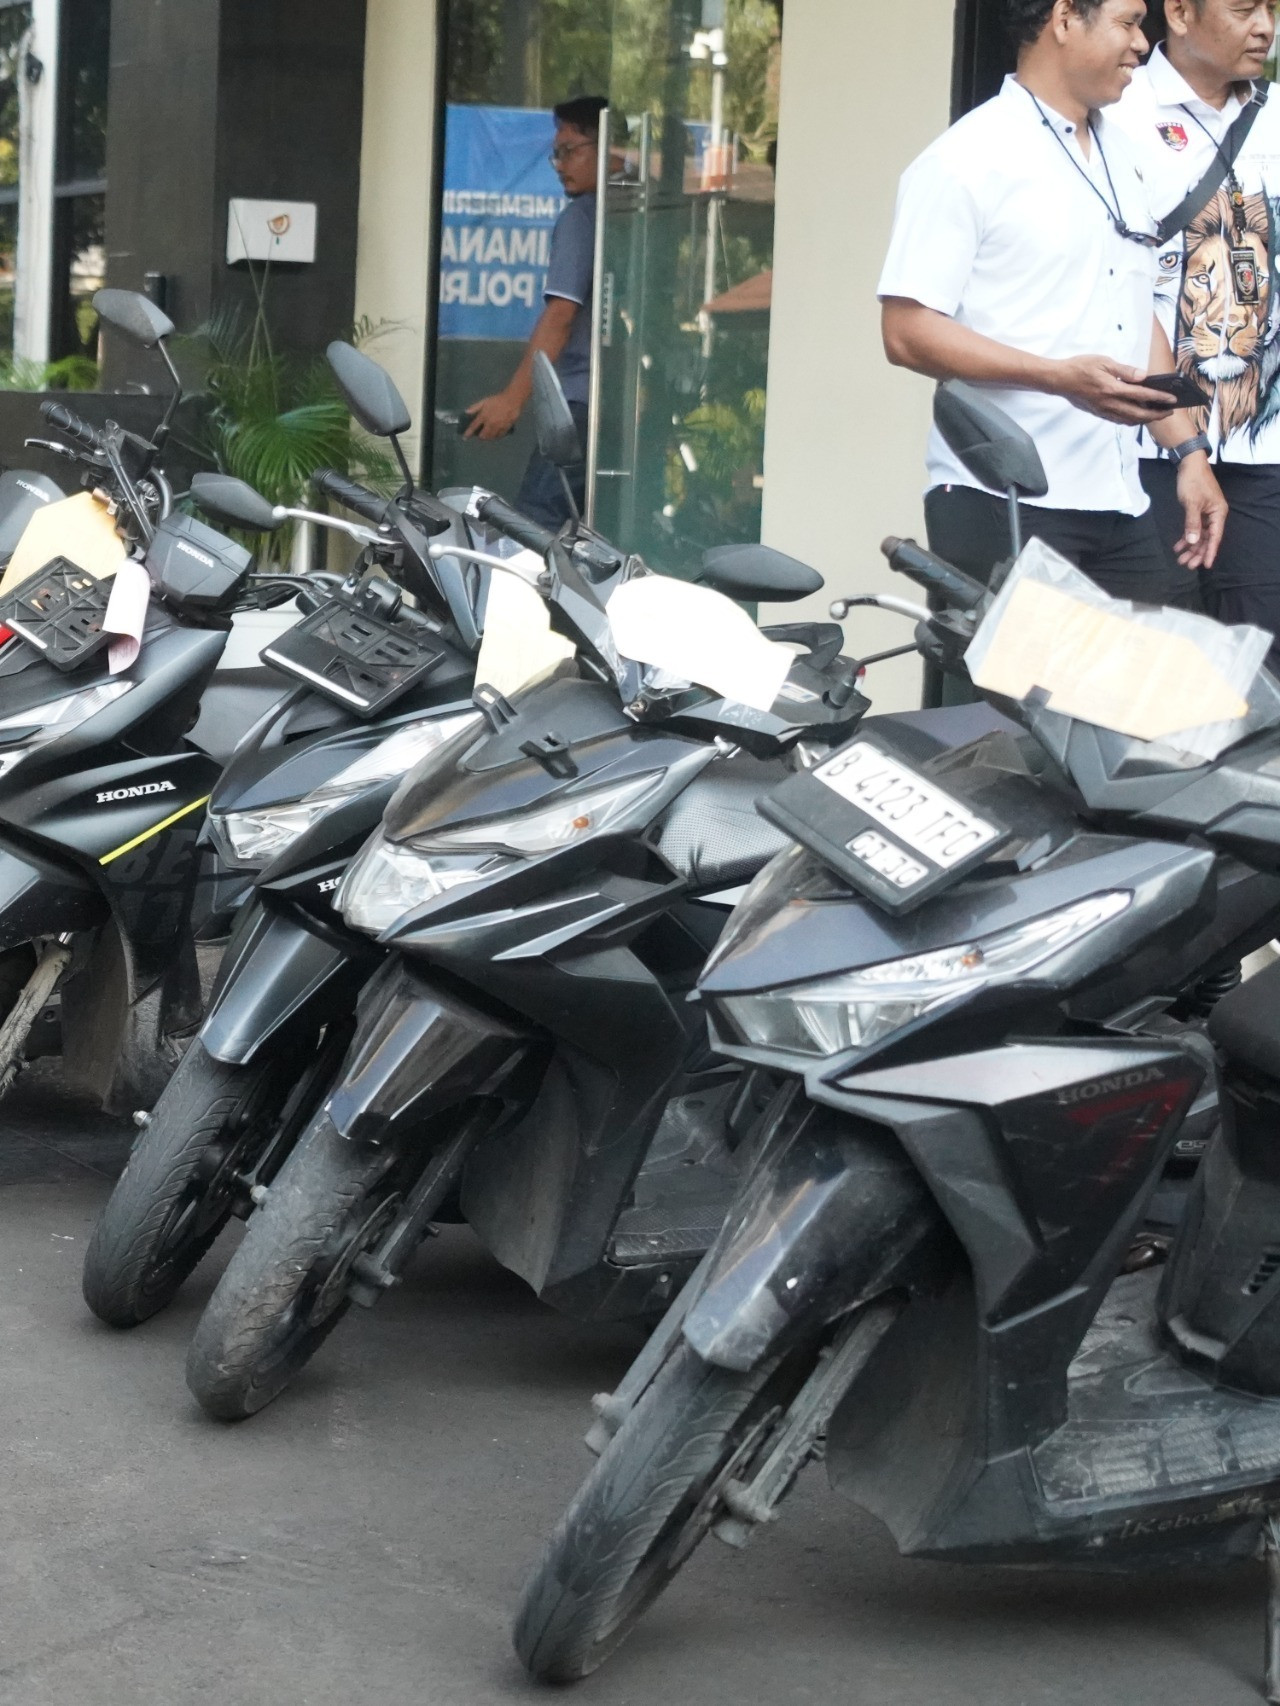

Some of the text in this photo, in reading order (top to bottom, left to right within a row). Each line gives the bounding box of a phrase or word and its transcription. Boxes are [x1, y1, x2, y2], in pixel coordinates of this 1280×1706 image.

[176, 541, 214, 568] HONDA
[96, 780, 177, 803] HONDA
[824, 750, 983, 858] B 4123 TFC
[1058, 1067, 1166, 1105] HONDA
